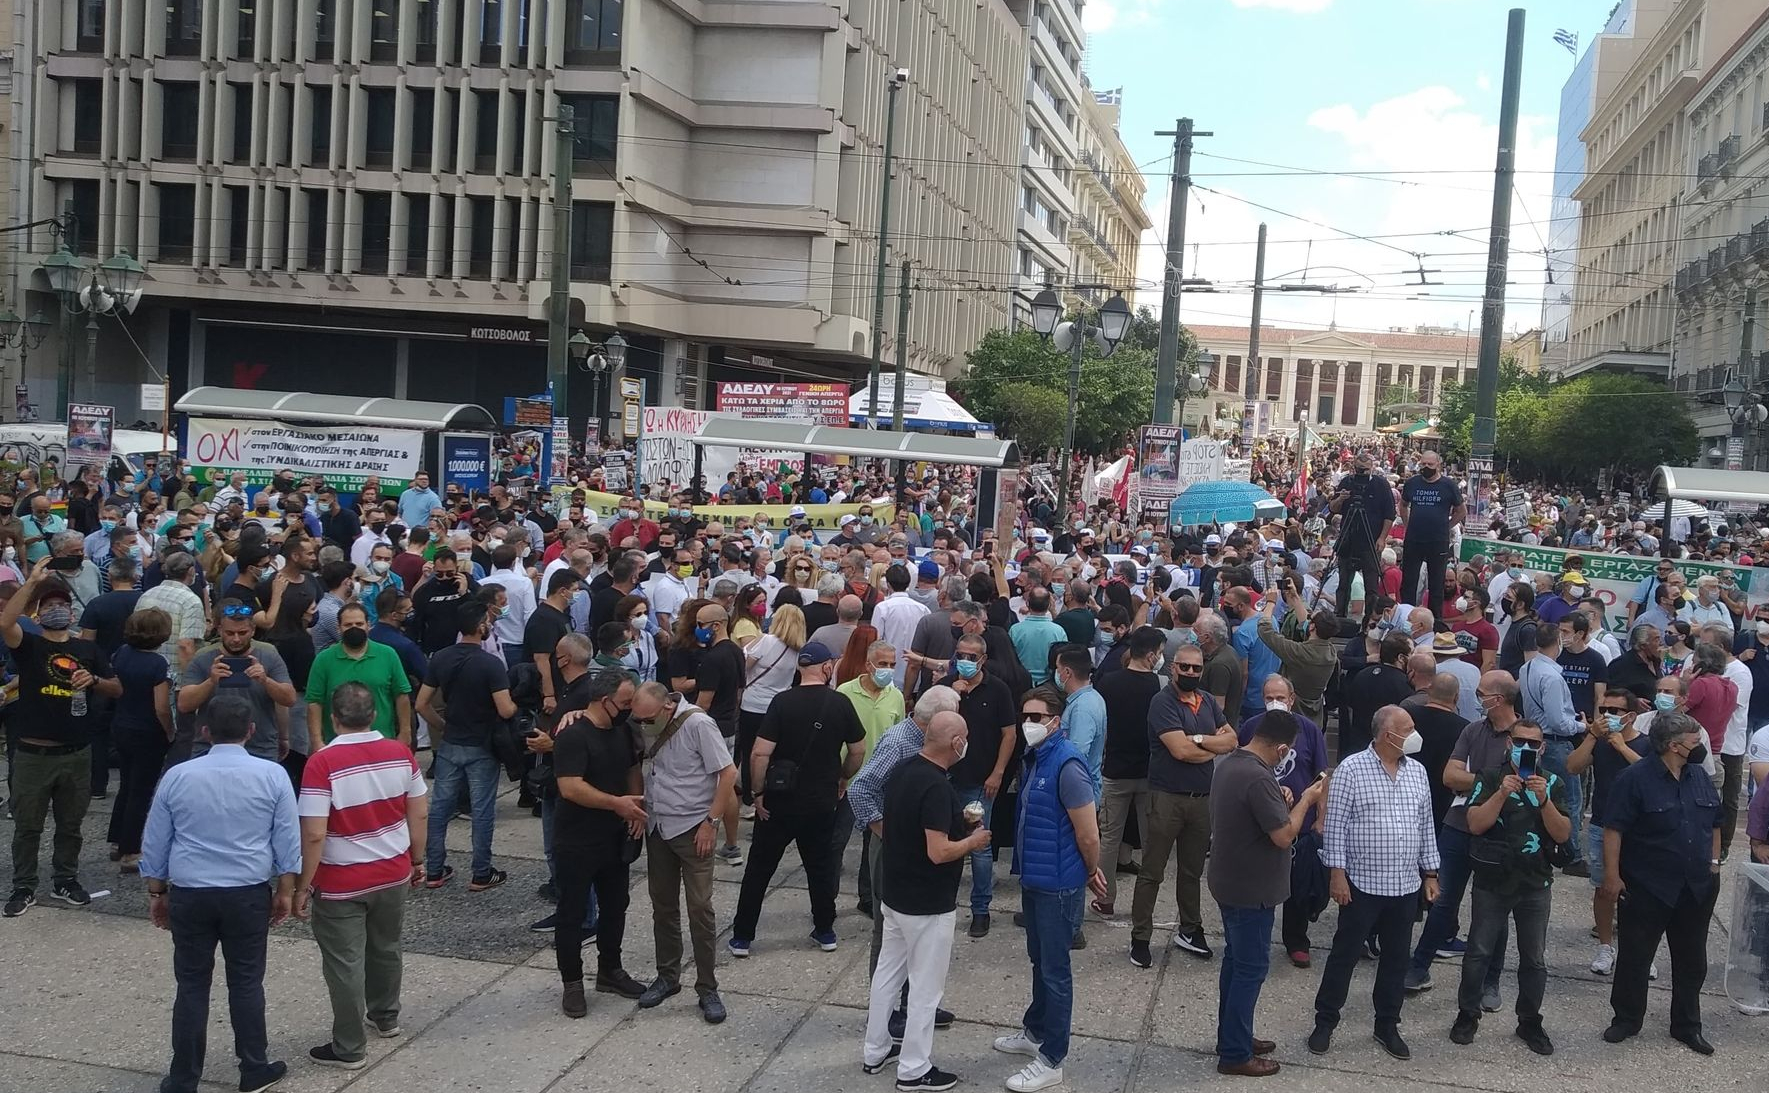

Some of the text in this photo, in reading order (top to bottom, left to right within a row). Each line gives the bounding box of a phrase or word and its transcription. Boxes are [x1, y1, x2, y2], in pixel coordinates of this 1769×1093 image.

[471, 328, 531, 341] ΚΩΤΣΟΒΟΛΟΣ
[722, 384, 774, 395] ΑΔΕΔΥ
[72, 406, 111, 416] ΑΔΕΔΥ
[251, 428, 379, 443] στον ΕΡΓΑΣΙΑΚΟ ΜΕΣΑΙΩΝΑ
[1146, 428, 1178, 438] ΑΔΕΔΥ
[197, 427, 240, 463] ΟΧΙ
[342, 448, 358, 457] της
[359, 447, 400, 459] ΑΠΕΡΓΙΑΣ
[401, 451, 409, 459] &
[354, 461, 390, 472] ΔΡΑΣΗΣ
[1566, 677, 1589, 685] LERY
